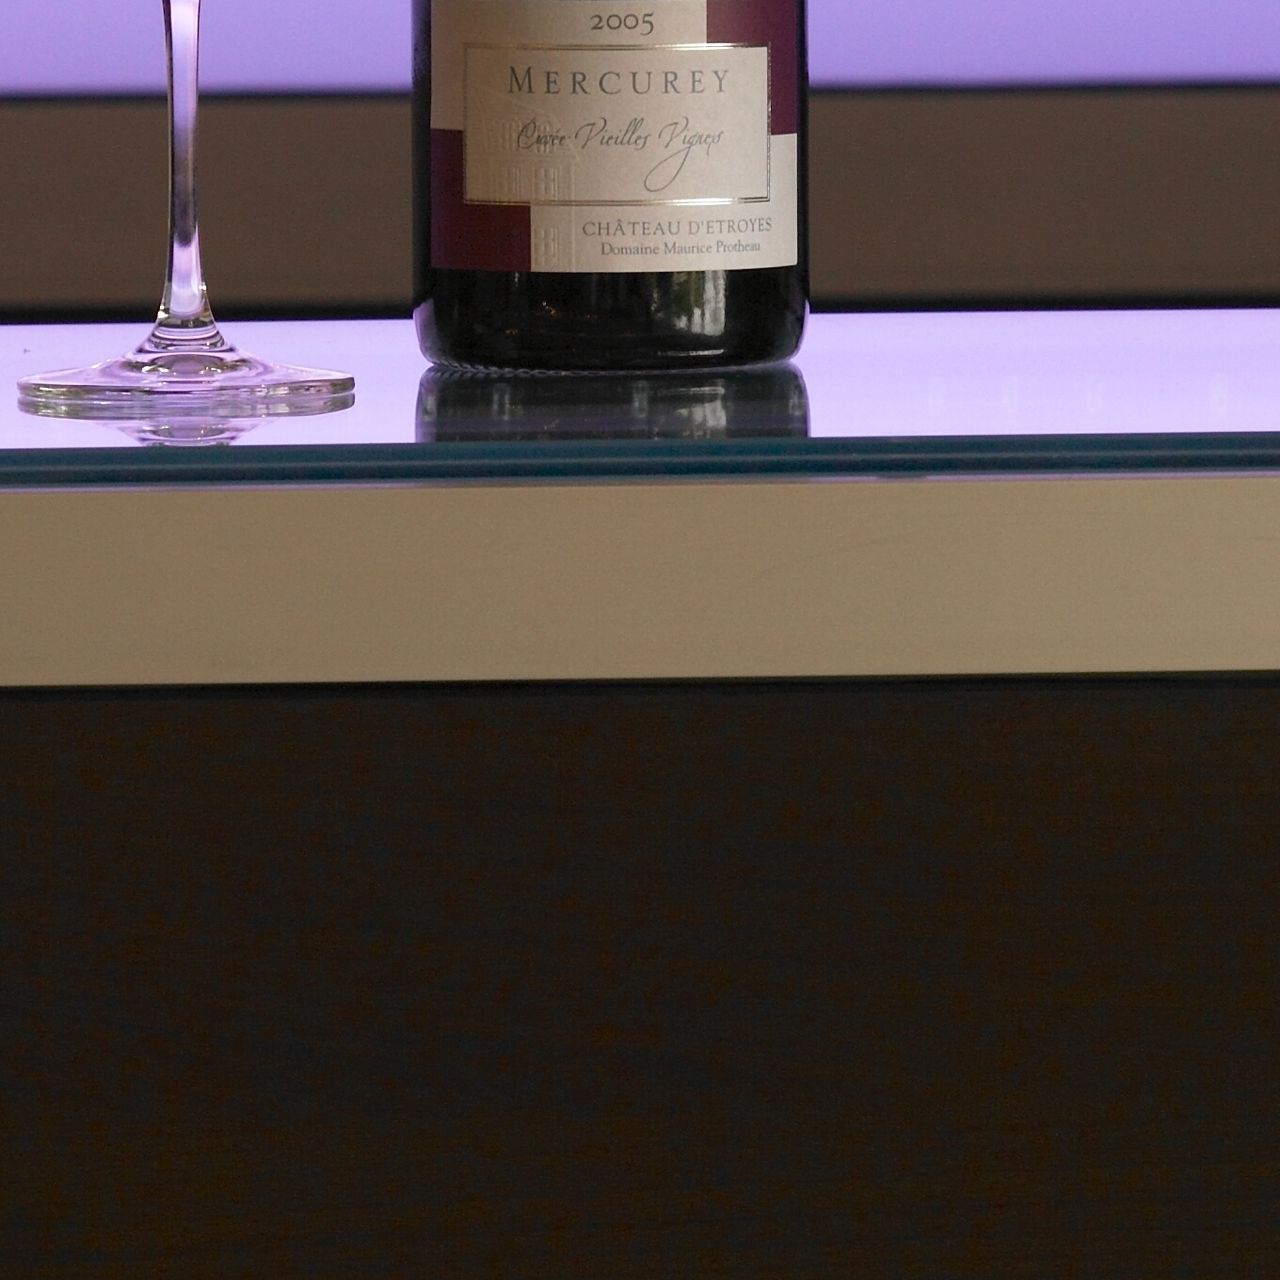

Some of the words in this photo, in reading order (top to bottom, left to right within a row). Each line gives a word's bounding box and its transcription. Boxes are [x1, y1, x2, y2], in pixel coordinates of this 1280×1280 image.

[590, 13, 655, 35] 2005
[508, 65, 730, 95] MERCUREY
[574, 116, 651, 150] Vieilles
[642, 116, 725, 193] Vignes
[581, 218, 681, 237] CHÂTEAU
[600, 241, 660, 257] Domaine
[663, 241, 713, 256] Maurice
[715, 239, 761, 253] Protheau
